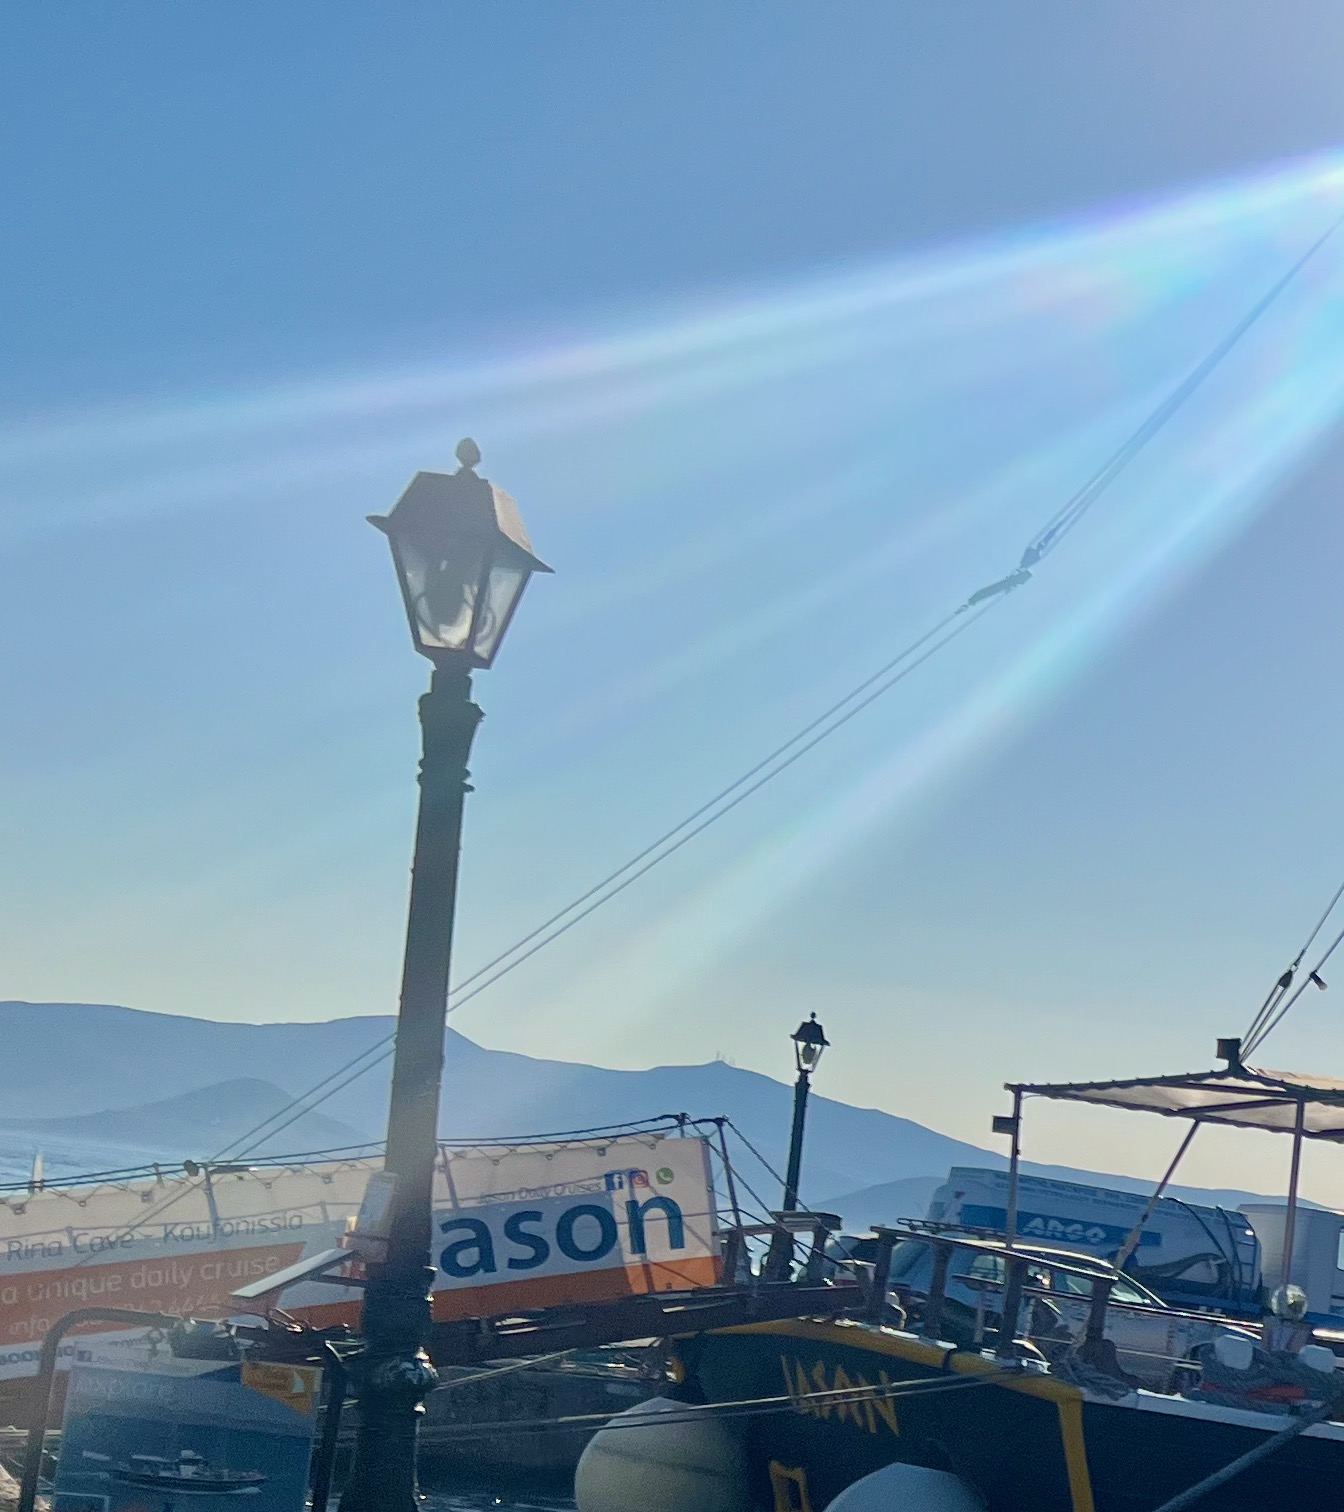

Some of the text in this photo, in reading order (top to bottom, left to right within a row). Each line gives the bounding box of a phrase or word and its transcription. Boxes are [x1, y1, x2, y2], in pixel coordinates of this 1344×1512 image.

[72, 1229, 136, 1255] Cave
[162, 1210, 306, 1245] Koufonissia
[439, 1195, 686, 1279] ason
[27, 1272, 123, 1302] unique
[130, 1262, 194, 1291] daily
[199, 1252, 280, 1281] cruise
